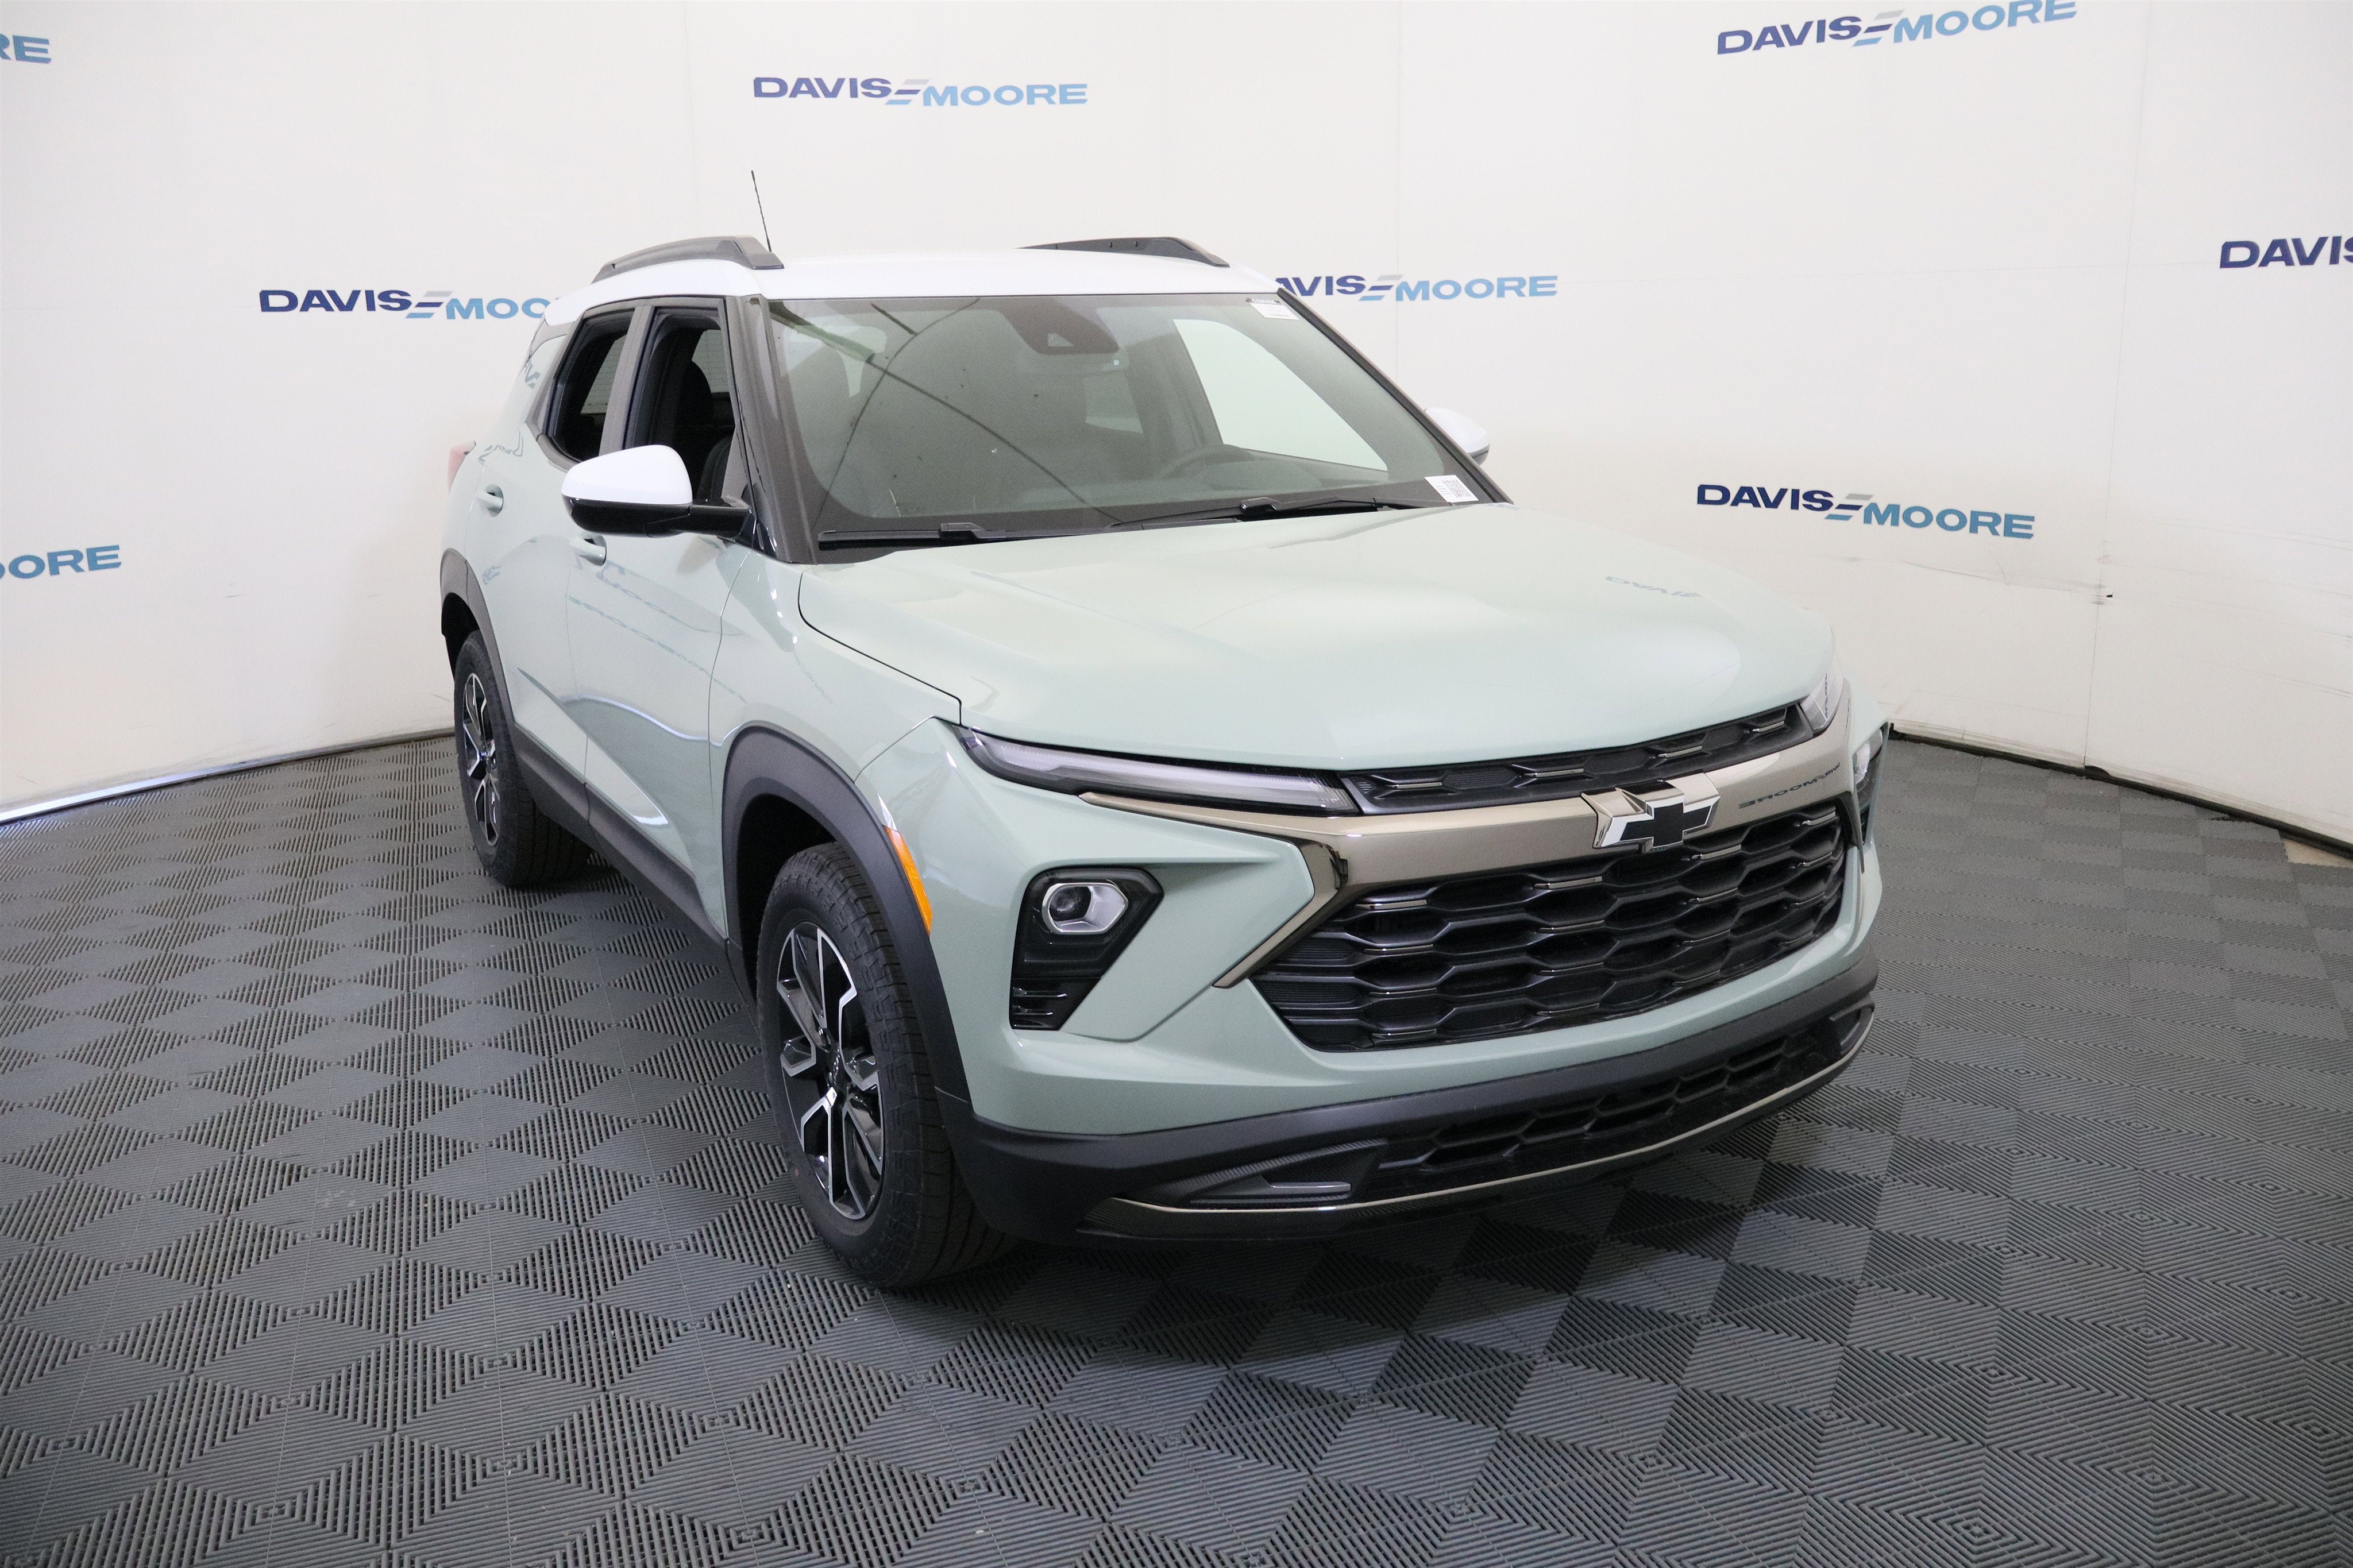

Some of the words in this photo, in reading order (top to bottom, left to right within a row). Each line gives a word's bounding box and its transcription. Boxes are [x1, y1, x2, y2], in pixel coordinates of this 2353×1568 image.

[1718, 16, 1862, 55] DAVIS
[1893, 0, 2077, 43] MOORE
[754, 78, 892, 98] DAVIS
[923, 84, 1088, 106] MOORE
[2219, 236, 2353, 269] DAVI
[259, 289, 412, 312] DAVIS
[446, 298, 551, 320] MOO
[1395, 275, 1558, 302] MOORE
[1697, 484, 1834, 512] DAVIS
[1862, 502, 2035, 539] MOORE
[0, 544, 122, 580] ORE
